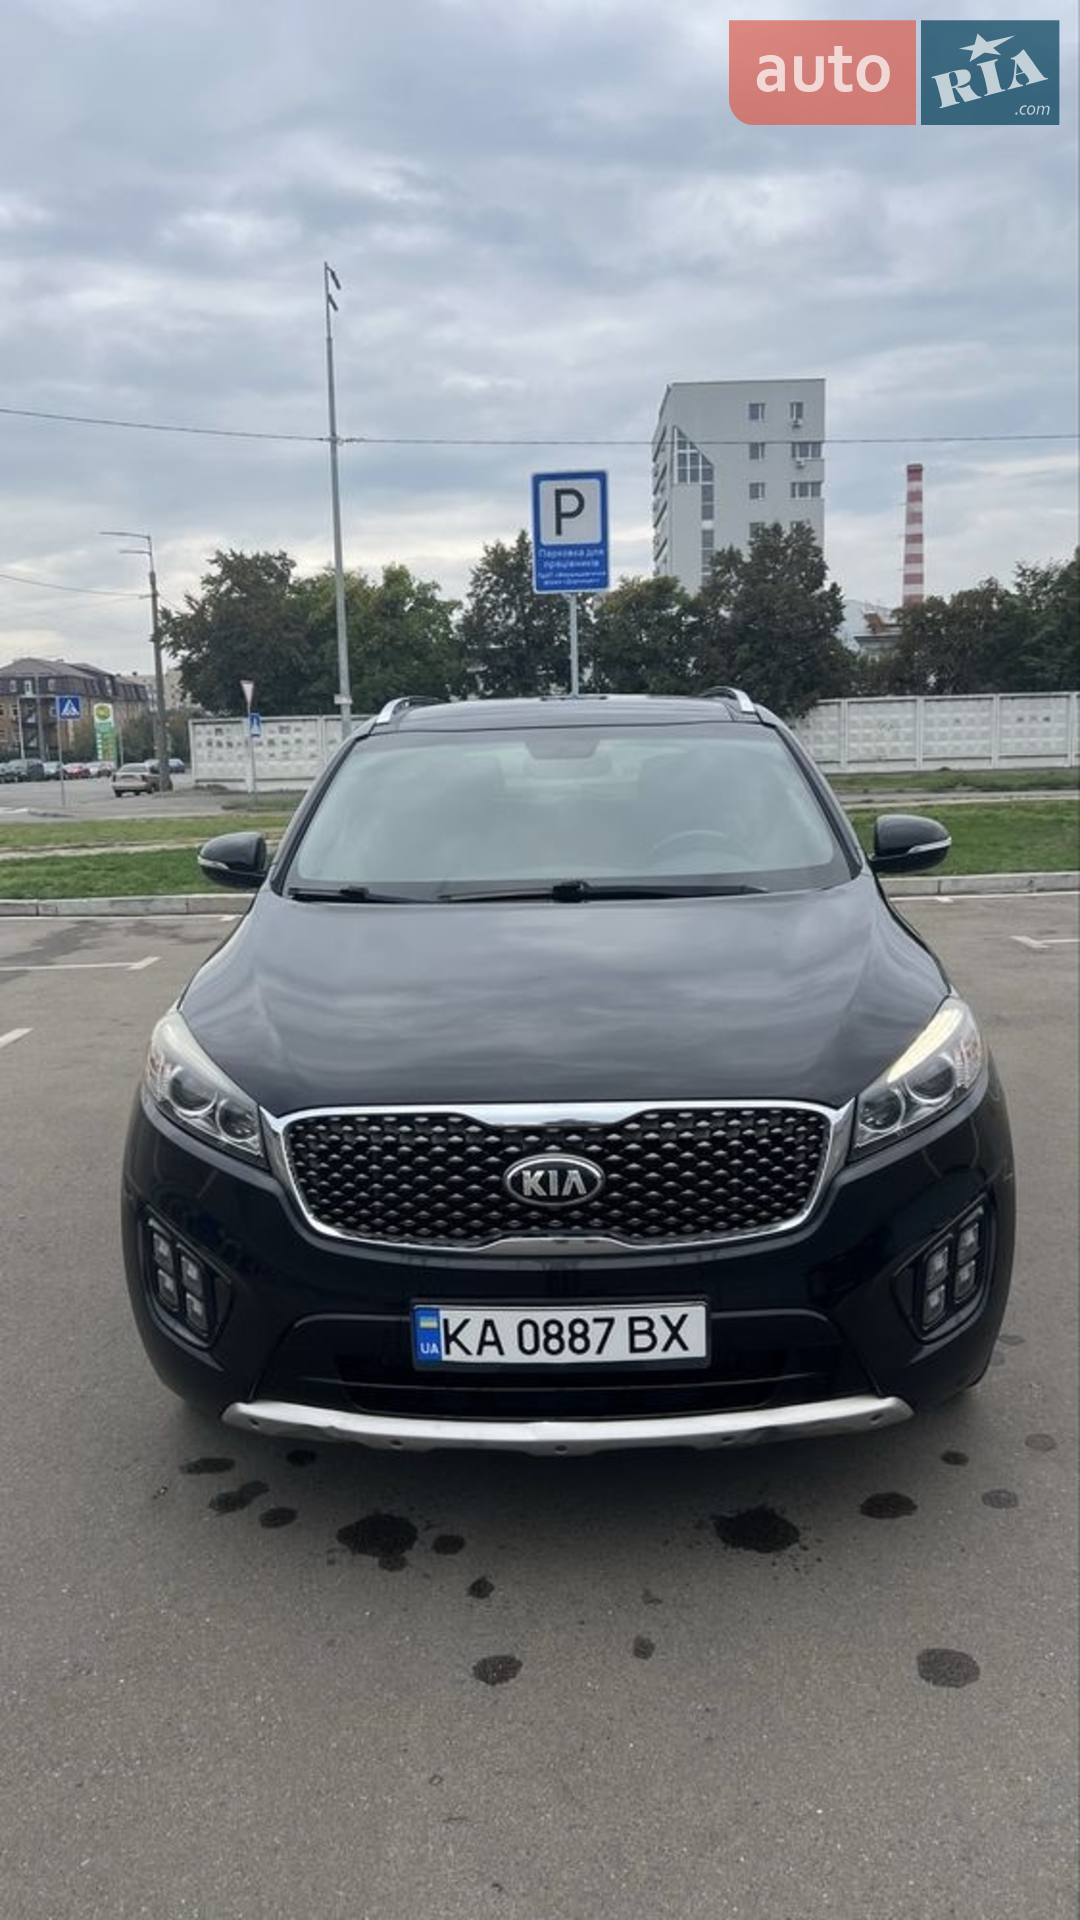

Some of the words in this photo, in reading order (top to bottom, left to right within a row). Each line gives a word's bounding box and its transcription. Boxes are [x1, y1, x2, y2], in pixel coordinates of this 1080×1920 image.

[554, 487, 585, 536] P
[521, 1169, 587, 1197] KIA
[420, 1342, 440, 1354] UA
[443, 1318, 505, 1356] KA
[516, 1317, 616, 1356] 0887
[627, 1313, 690, 1354] BX
